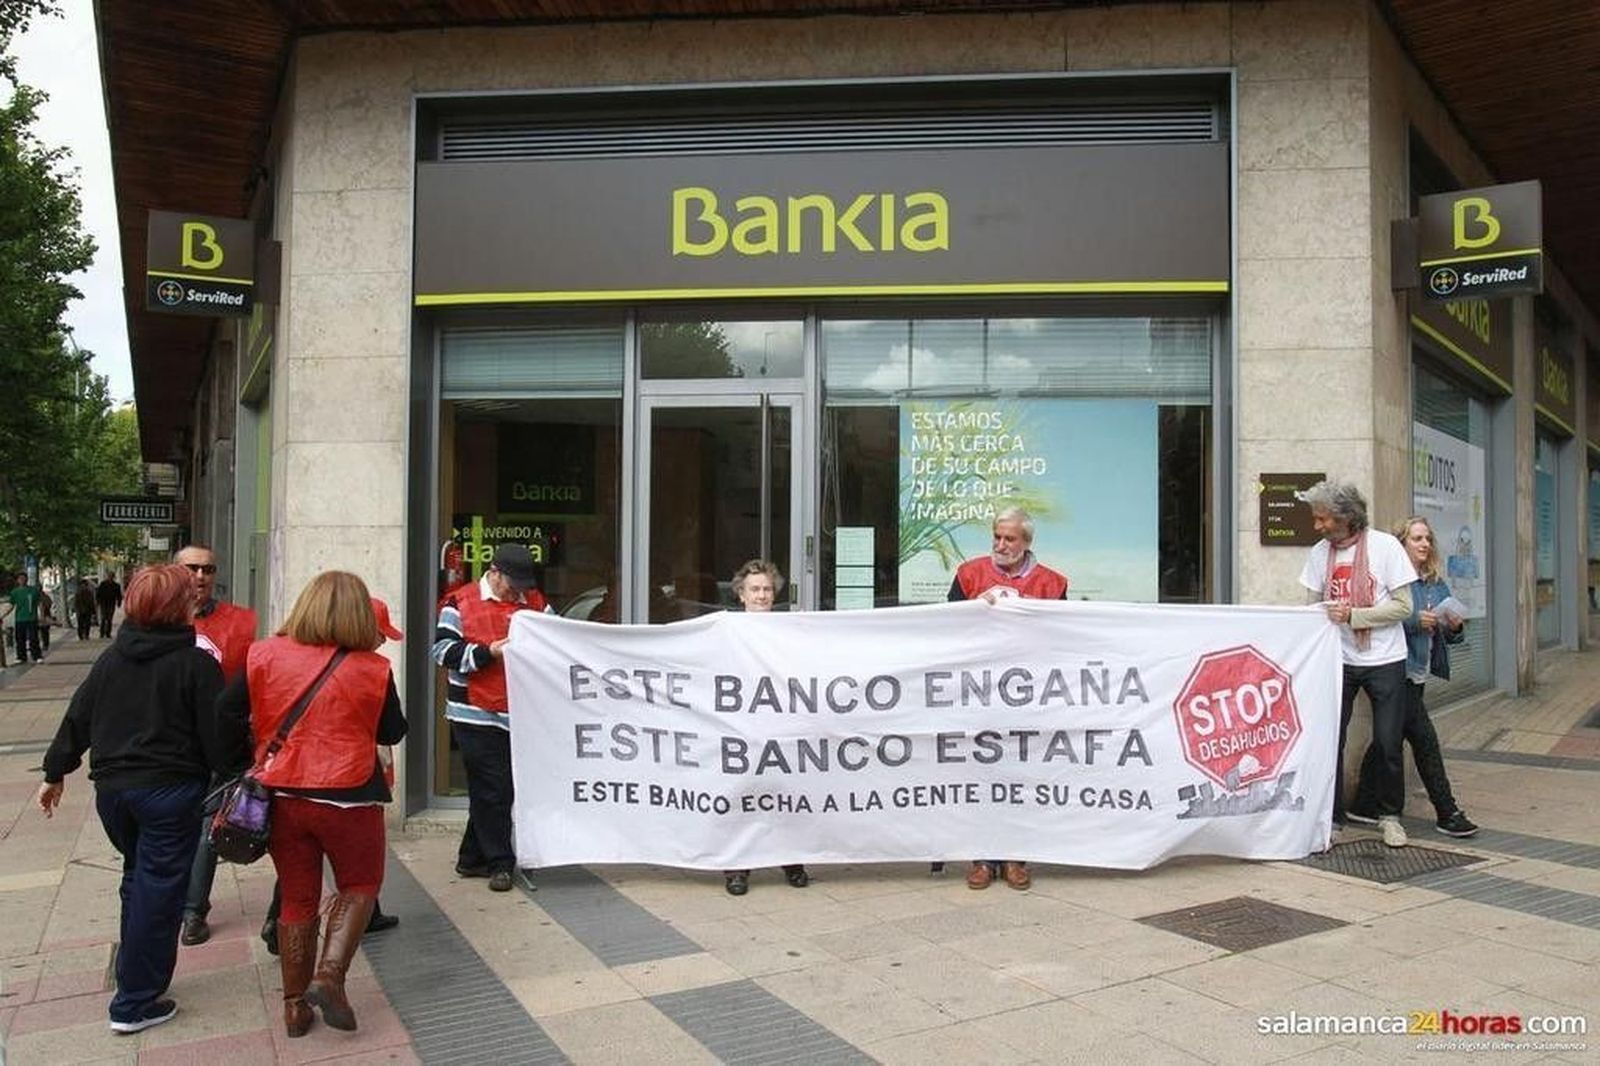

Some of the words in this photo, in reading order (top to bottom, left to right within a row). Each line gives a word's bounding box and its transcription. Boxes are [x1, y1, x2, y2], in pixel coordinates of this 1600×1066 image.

[672, 187, 949, 256] Bankia
[1454, 197, 1501, 250] B
[181, 222, 224, 270] B
[1462, 266, 1527, 286] ServiRed
[187, 289, 244, 306] ServiRed
[911, 411, 1003, 430] ESTAMOS
[960, 434, 1025, 452] CERCA
[911, 457, 937, 475] DE
[943, 457, 969, 475] SU
[975, 457, 1047, 475] CAMPO
[512, 481, 582, 501] Bankia
[911, 480, 935, 497] DE
[973, 480, 1015, 501] QUE
[911, 503, 996, 520] IMAGINA
[533, 526, 542, 539] A
[463, 542, 542, 562] Baa
[569, 664, 692, 709] ESTE
[714, 674, 901, 714] BANCO
[924, 660, 1150, 708] ENGAÑA
[1189, 678, 1284, 736] STOP
[575, 723, 700, 768] ESTE
[721, 734, 913, 776] BANCO
[937, 728, 1153, 767] ESTAFA
[1198, 720, 1290, 761] DESAHUCIOS
[573, 781, 639, 804] ESTE
[649, 784, 730, 815] BANCO
[741, 794, 813, 813] ECHA
[822, 794, 839, 813] A
[849, 790, 884, 812] LA
[892, 783, 980, 808] GENTE
[991, 783, 1024, 804] DE
[1035, 784, 1070, 807] SU
[1079, 787, 1153, 811] CASA
